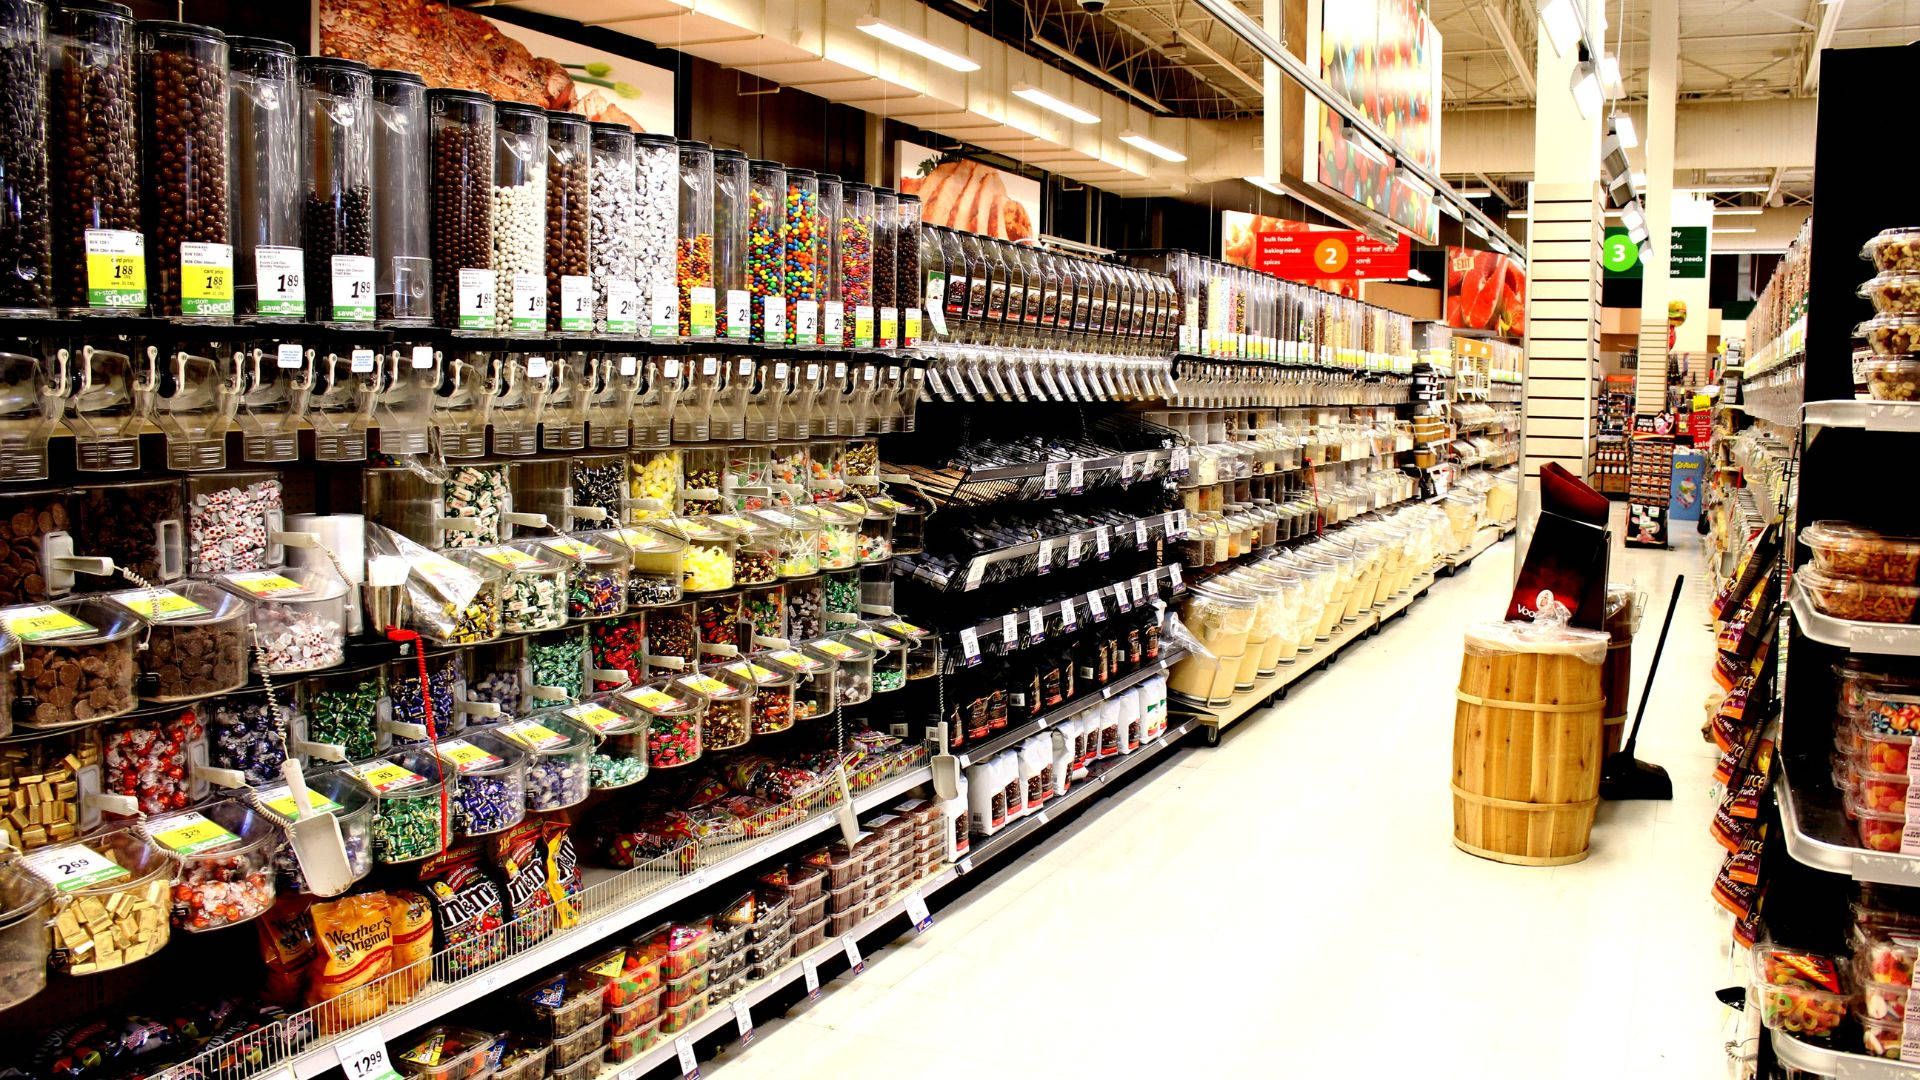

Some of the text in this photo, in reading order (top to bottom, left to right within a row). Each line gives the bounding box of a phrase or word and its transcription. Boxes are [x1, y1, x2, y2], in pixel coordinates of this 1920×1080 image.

[1325, 248, 1338, 265] 2
[1612, 244, 1626, 262] 3
[105, 290, 145, 306] special
[197, 300, 233, 315] special
